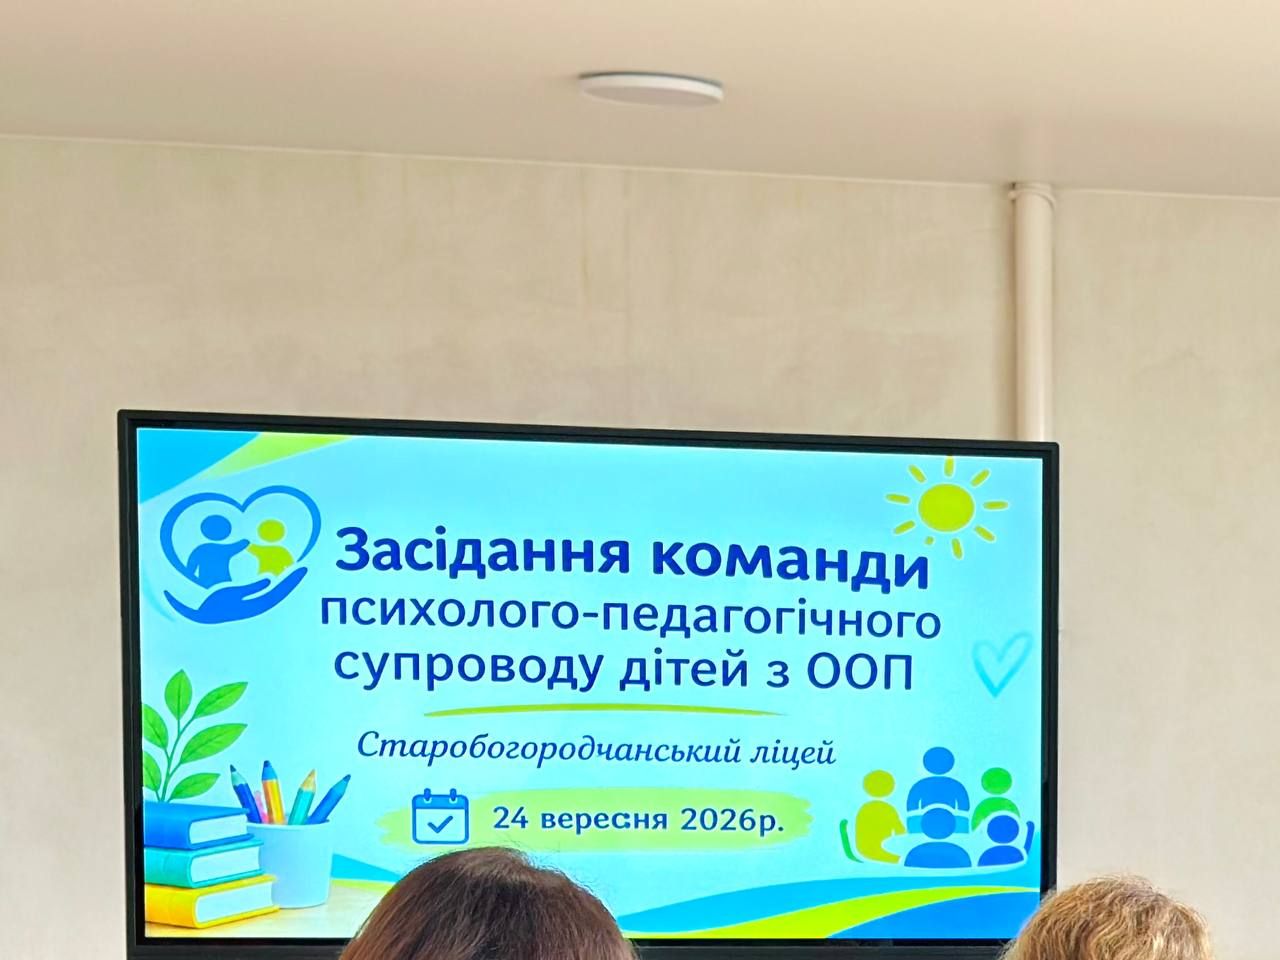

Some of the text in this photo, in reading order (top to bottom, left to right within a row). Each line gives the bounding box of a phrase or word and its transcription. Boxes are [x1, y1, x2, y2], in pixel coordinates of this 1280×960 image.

[335, 525, 930, 595] Засідання команди
[321, 596, 941, 640] психолого-педагогічного
[334, 647, 913, 692] супроводу дітей з ООП
[357, 731, 837, 771] Старобогородчанський ліцей
[493, 806, 784, 837] 24 вересня 2026р.
